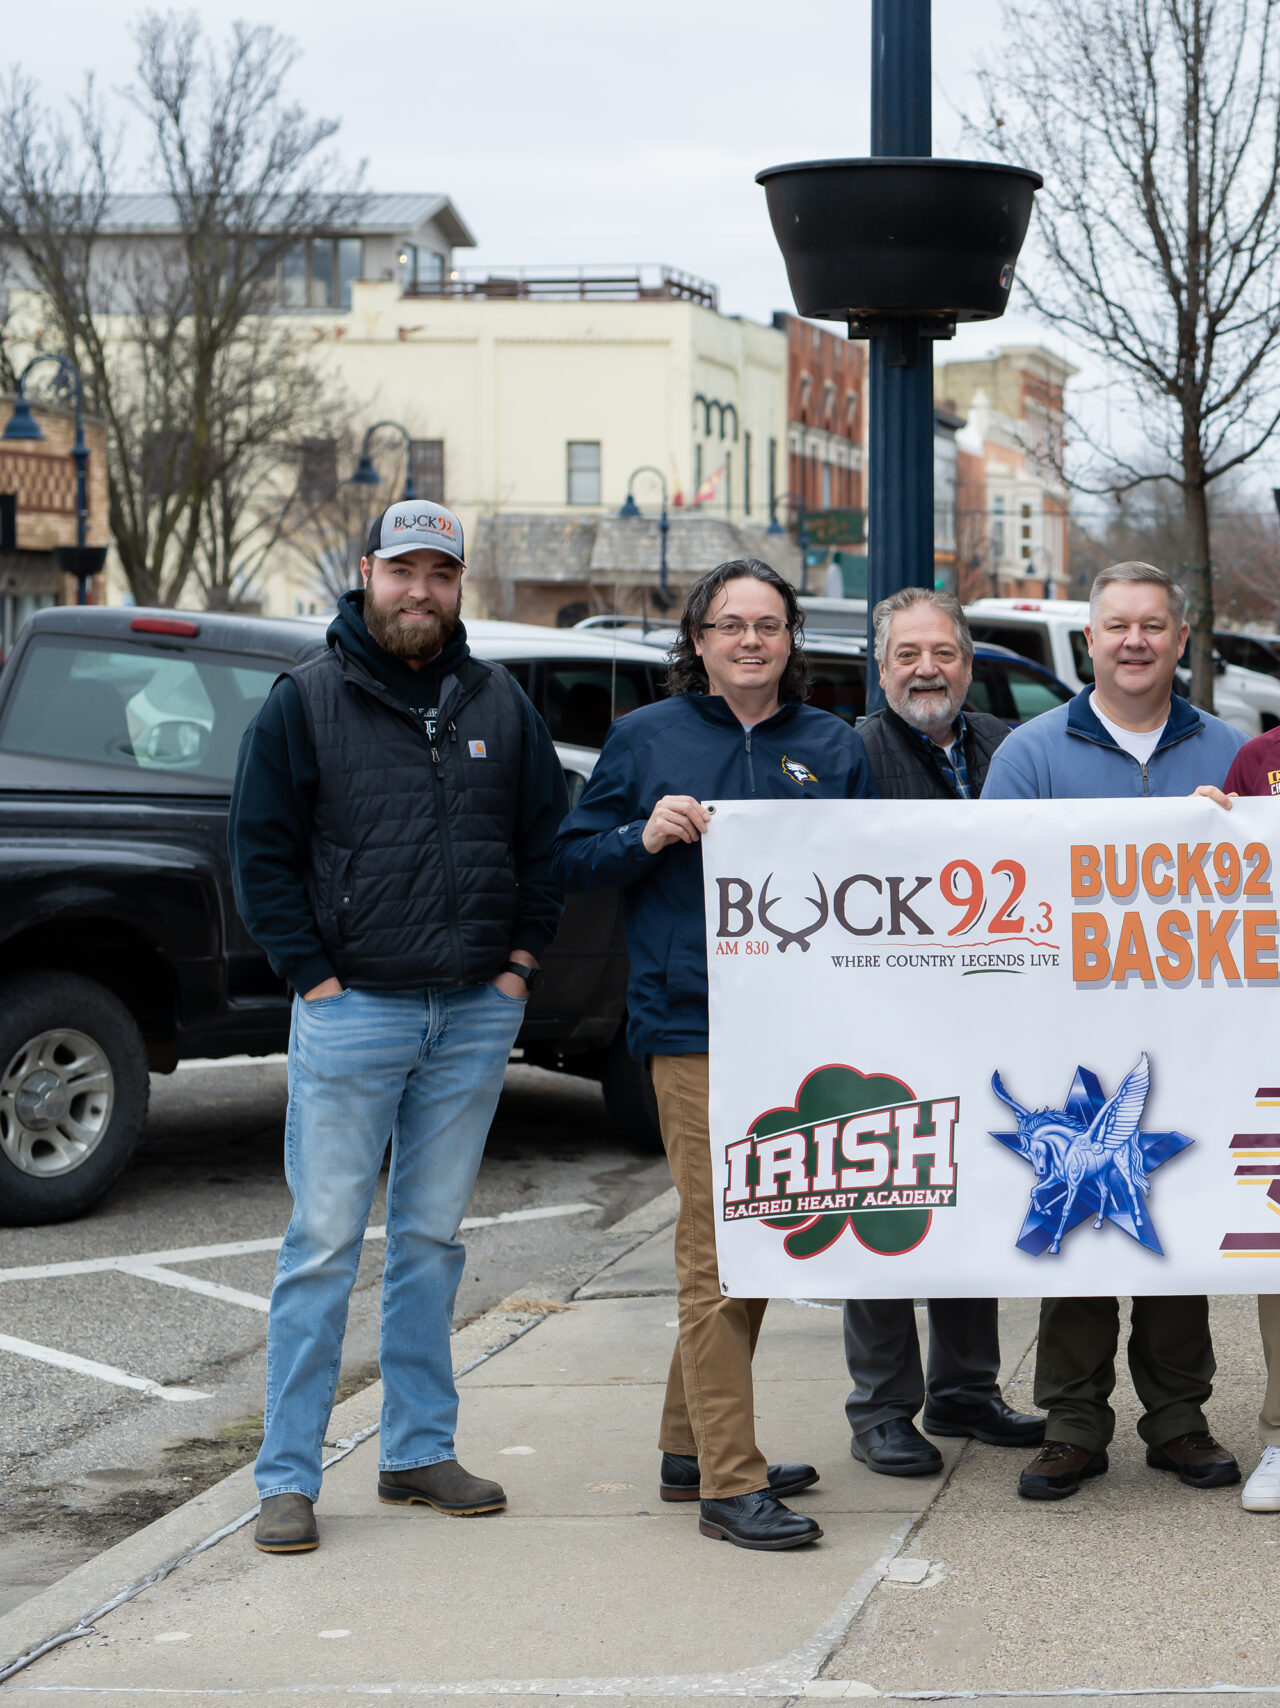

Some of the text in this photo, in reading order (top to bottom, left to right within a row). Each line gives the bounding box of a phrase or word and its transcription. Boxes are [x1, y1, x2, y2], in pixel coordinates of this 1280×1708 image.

[1070, 841, 1272, 899] BUCK92
[715, 940, 770, 955] AM 830
[831, 953, 1061, 968] WHERE COUNTRY LEGENDS LIVE
[725, 1099, 958, 1204] IRISH
[724, 1188, 955, 1221] SACRED HEART ACADEMY
